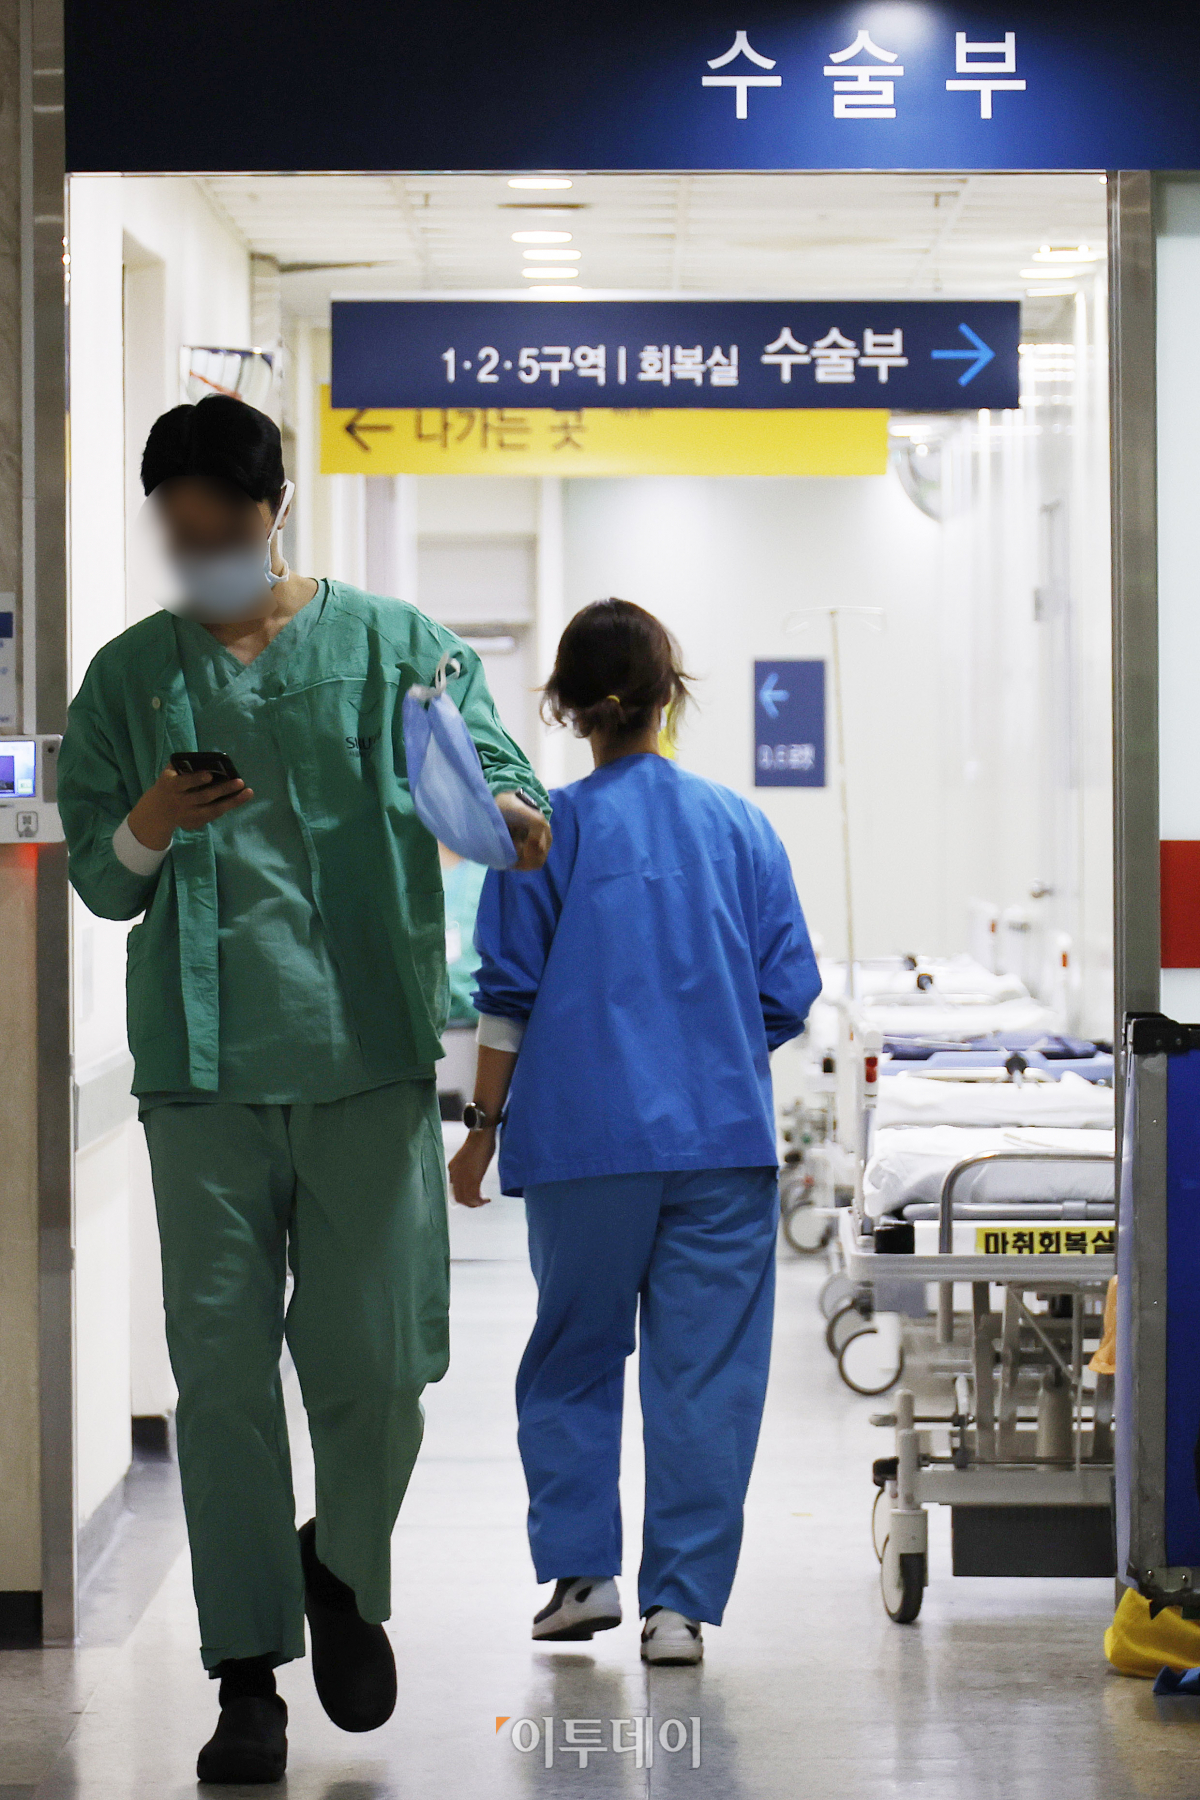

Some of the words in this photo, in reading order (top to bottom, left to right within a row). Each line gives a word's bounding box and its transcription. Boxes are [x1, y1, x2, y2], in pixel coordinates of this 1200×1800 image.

[637, 344, 739, 387] 회복실
[760, 326, 909, 384] 수술부
[414, 409, 531, 450] 나가는
